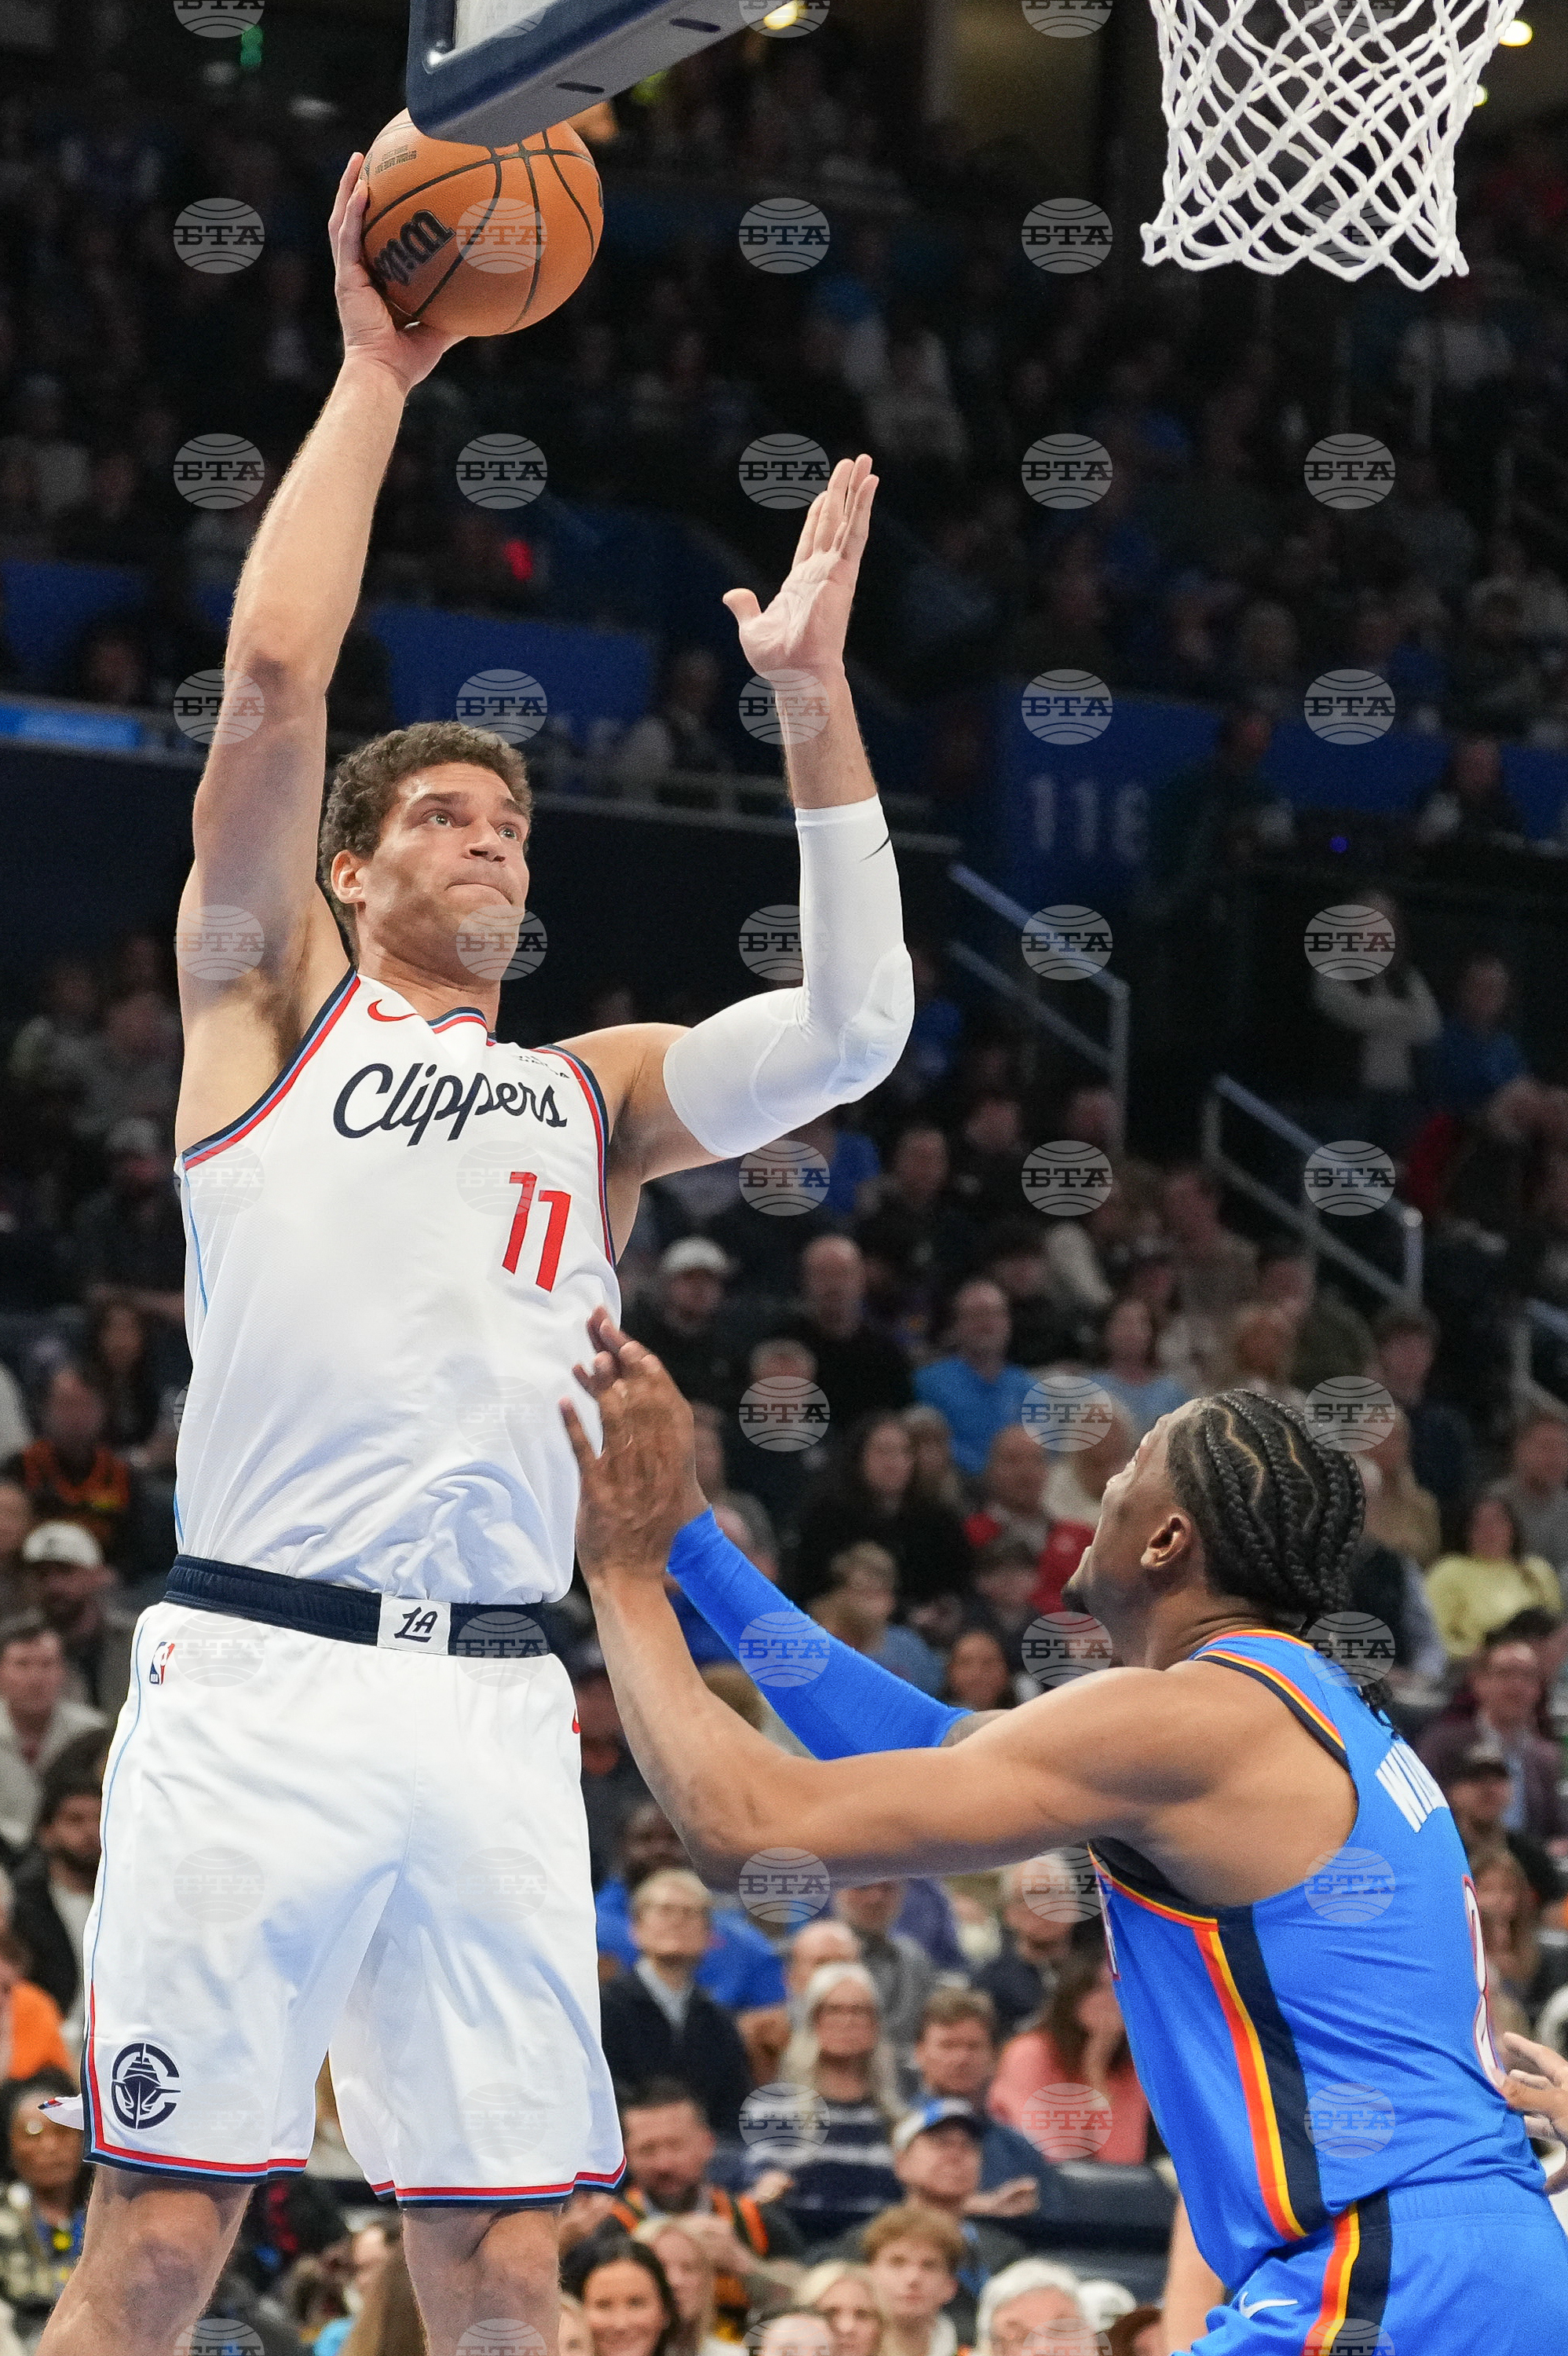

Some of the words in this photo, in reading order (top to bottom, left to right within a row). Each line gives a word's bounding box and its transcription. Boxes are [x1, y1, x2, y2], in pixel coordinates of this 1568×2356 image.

[333, 1063, 568, 1147] Clippers
[502, 1171, 572, 1293] 11
[393, 1606, 438, 1643] LA
